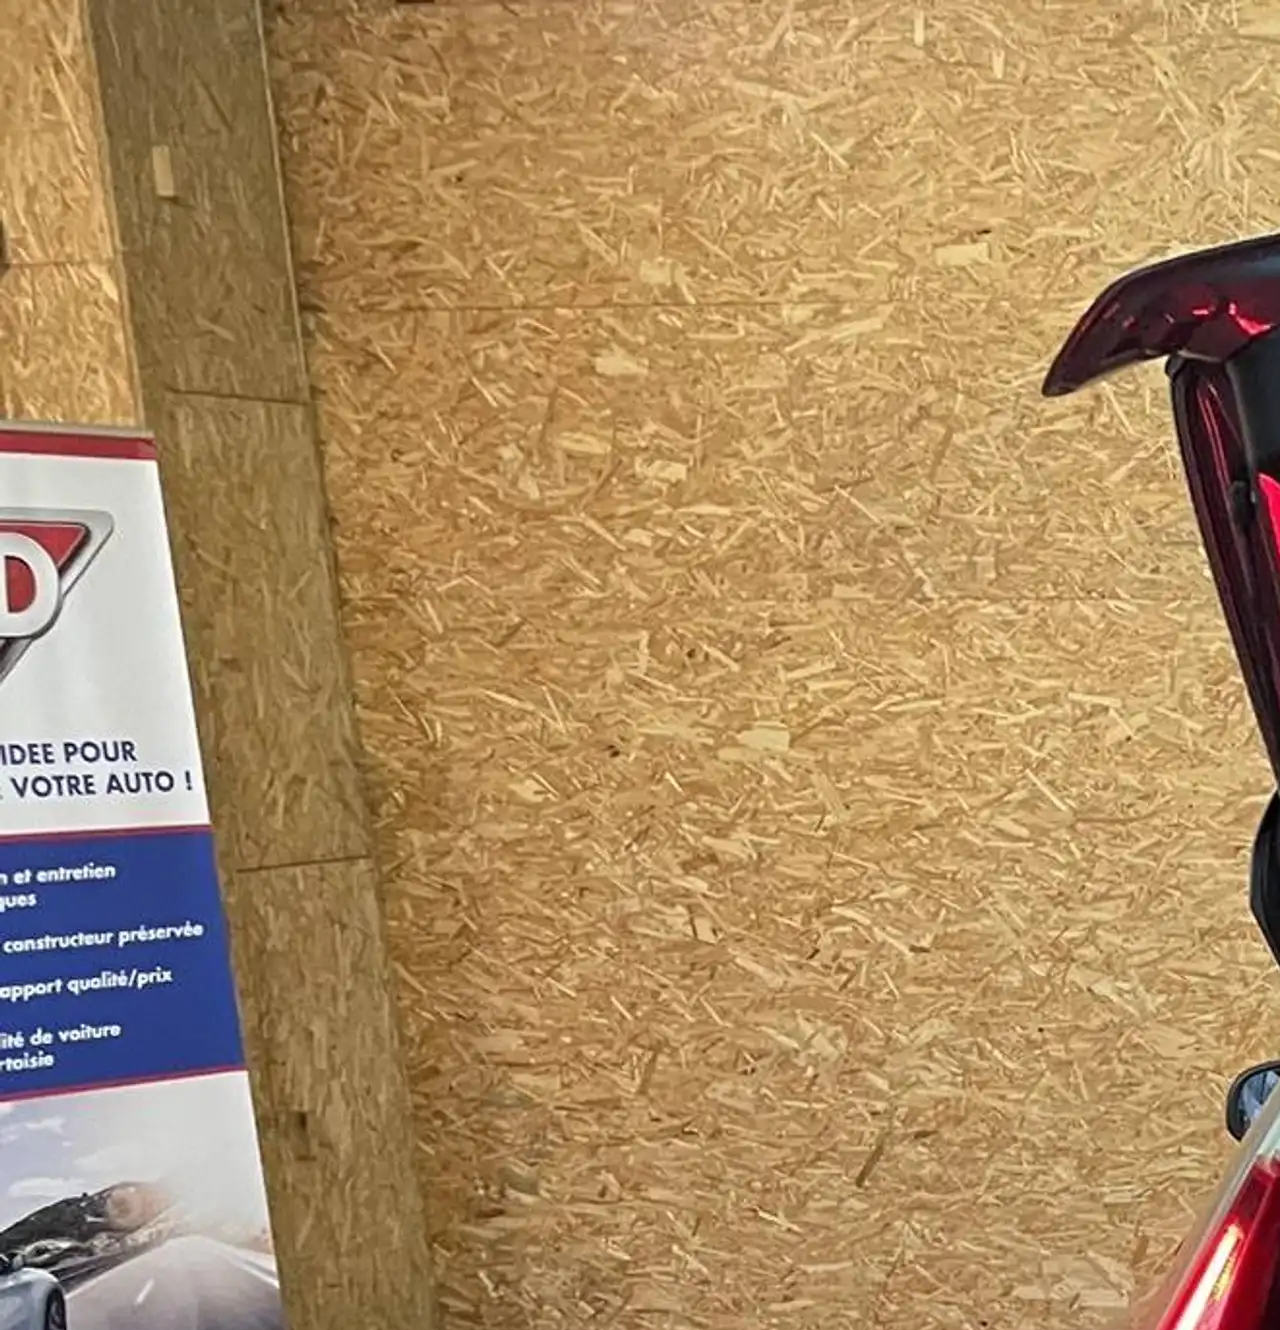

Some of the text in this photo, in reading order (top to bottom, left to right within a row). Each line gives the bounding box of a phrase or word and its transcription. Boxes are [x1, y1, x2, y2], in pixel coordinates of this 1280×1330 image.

[63, 740, 137, 763] POUR
[10, 773, 96, 798] VOTRE
[106, 770, 174, 794] AUTO
[13, 868, 32, 885] et
[36, 862, 117, 883] entretien
[0, 893, 37, 913] ques
[3, 920, 204, 954] constructeur préservée
[0, 966, 173, 1002] apport qualité/prix
[29, 1027, 53, 1045] de
[58, 1023, 122, 1043] voiture
[0, 1049, 55, 1071] rtoisie
